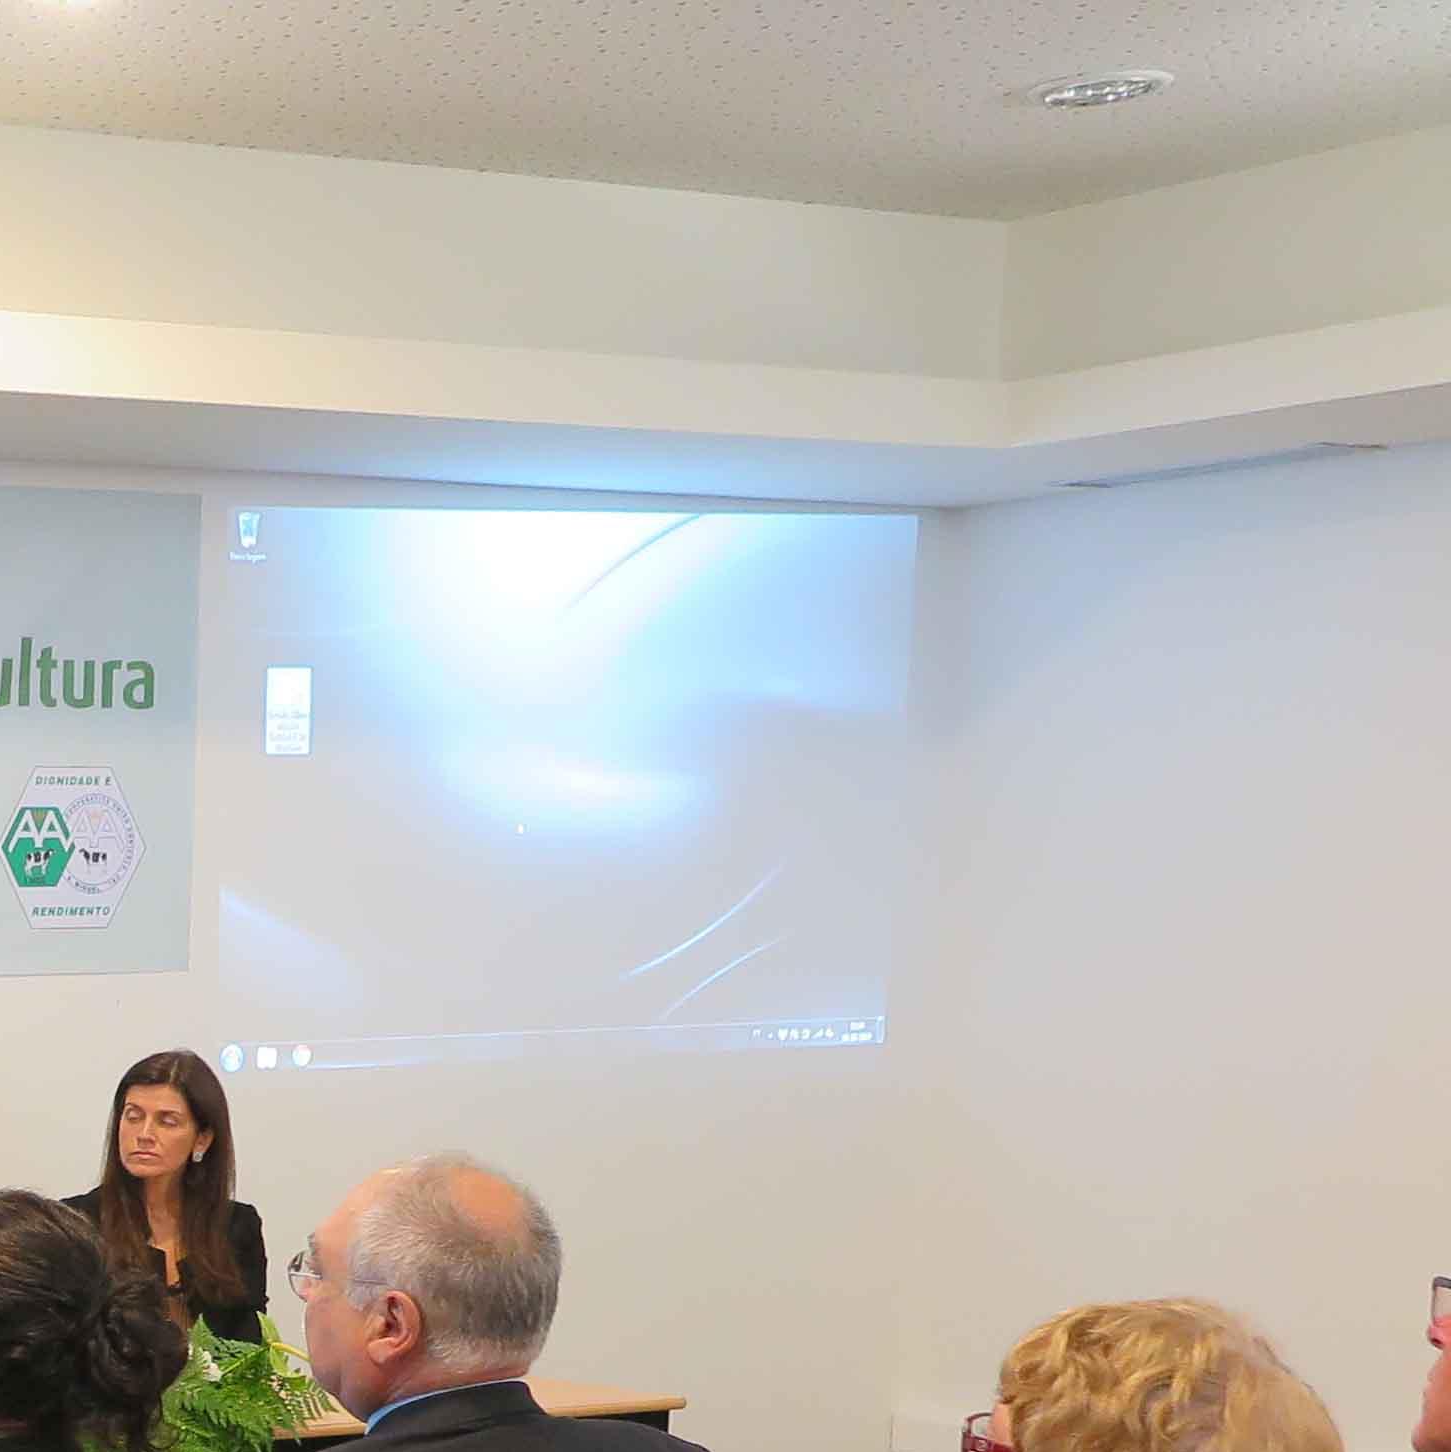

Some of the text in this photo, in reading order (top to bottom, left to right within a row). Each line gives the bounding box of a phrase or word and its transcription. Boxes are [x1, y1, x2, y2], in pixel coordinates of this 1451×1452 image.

[35, 775, 111, 785] DIGNIDADE E
[32, 905, 110, 916] RENDIMENTO
